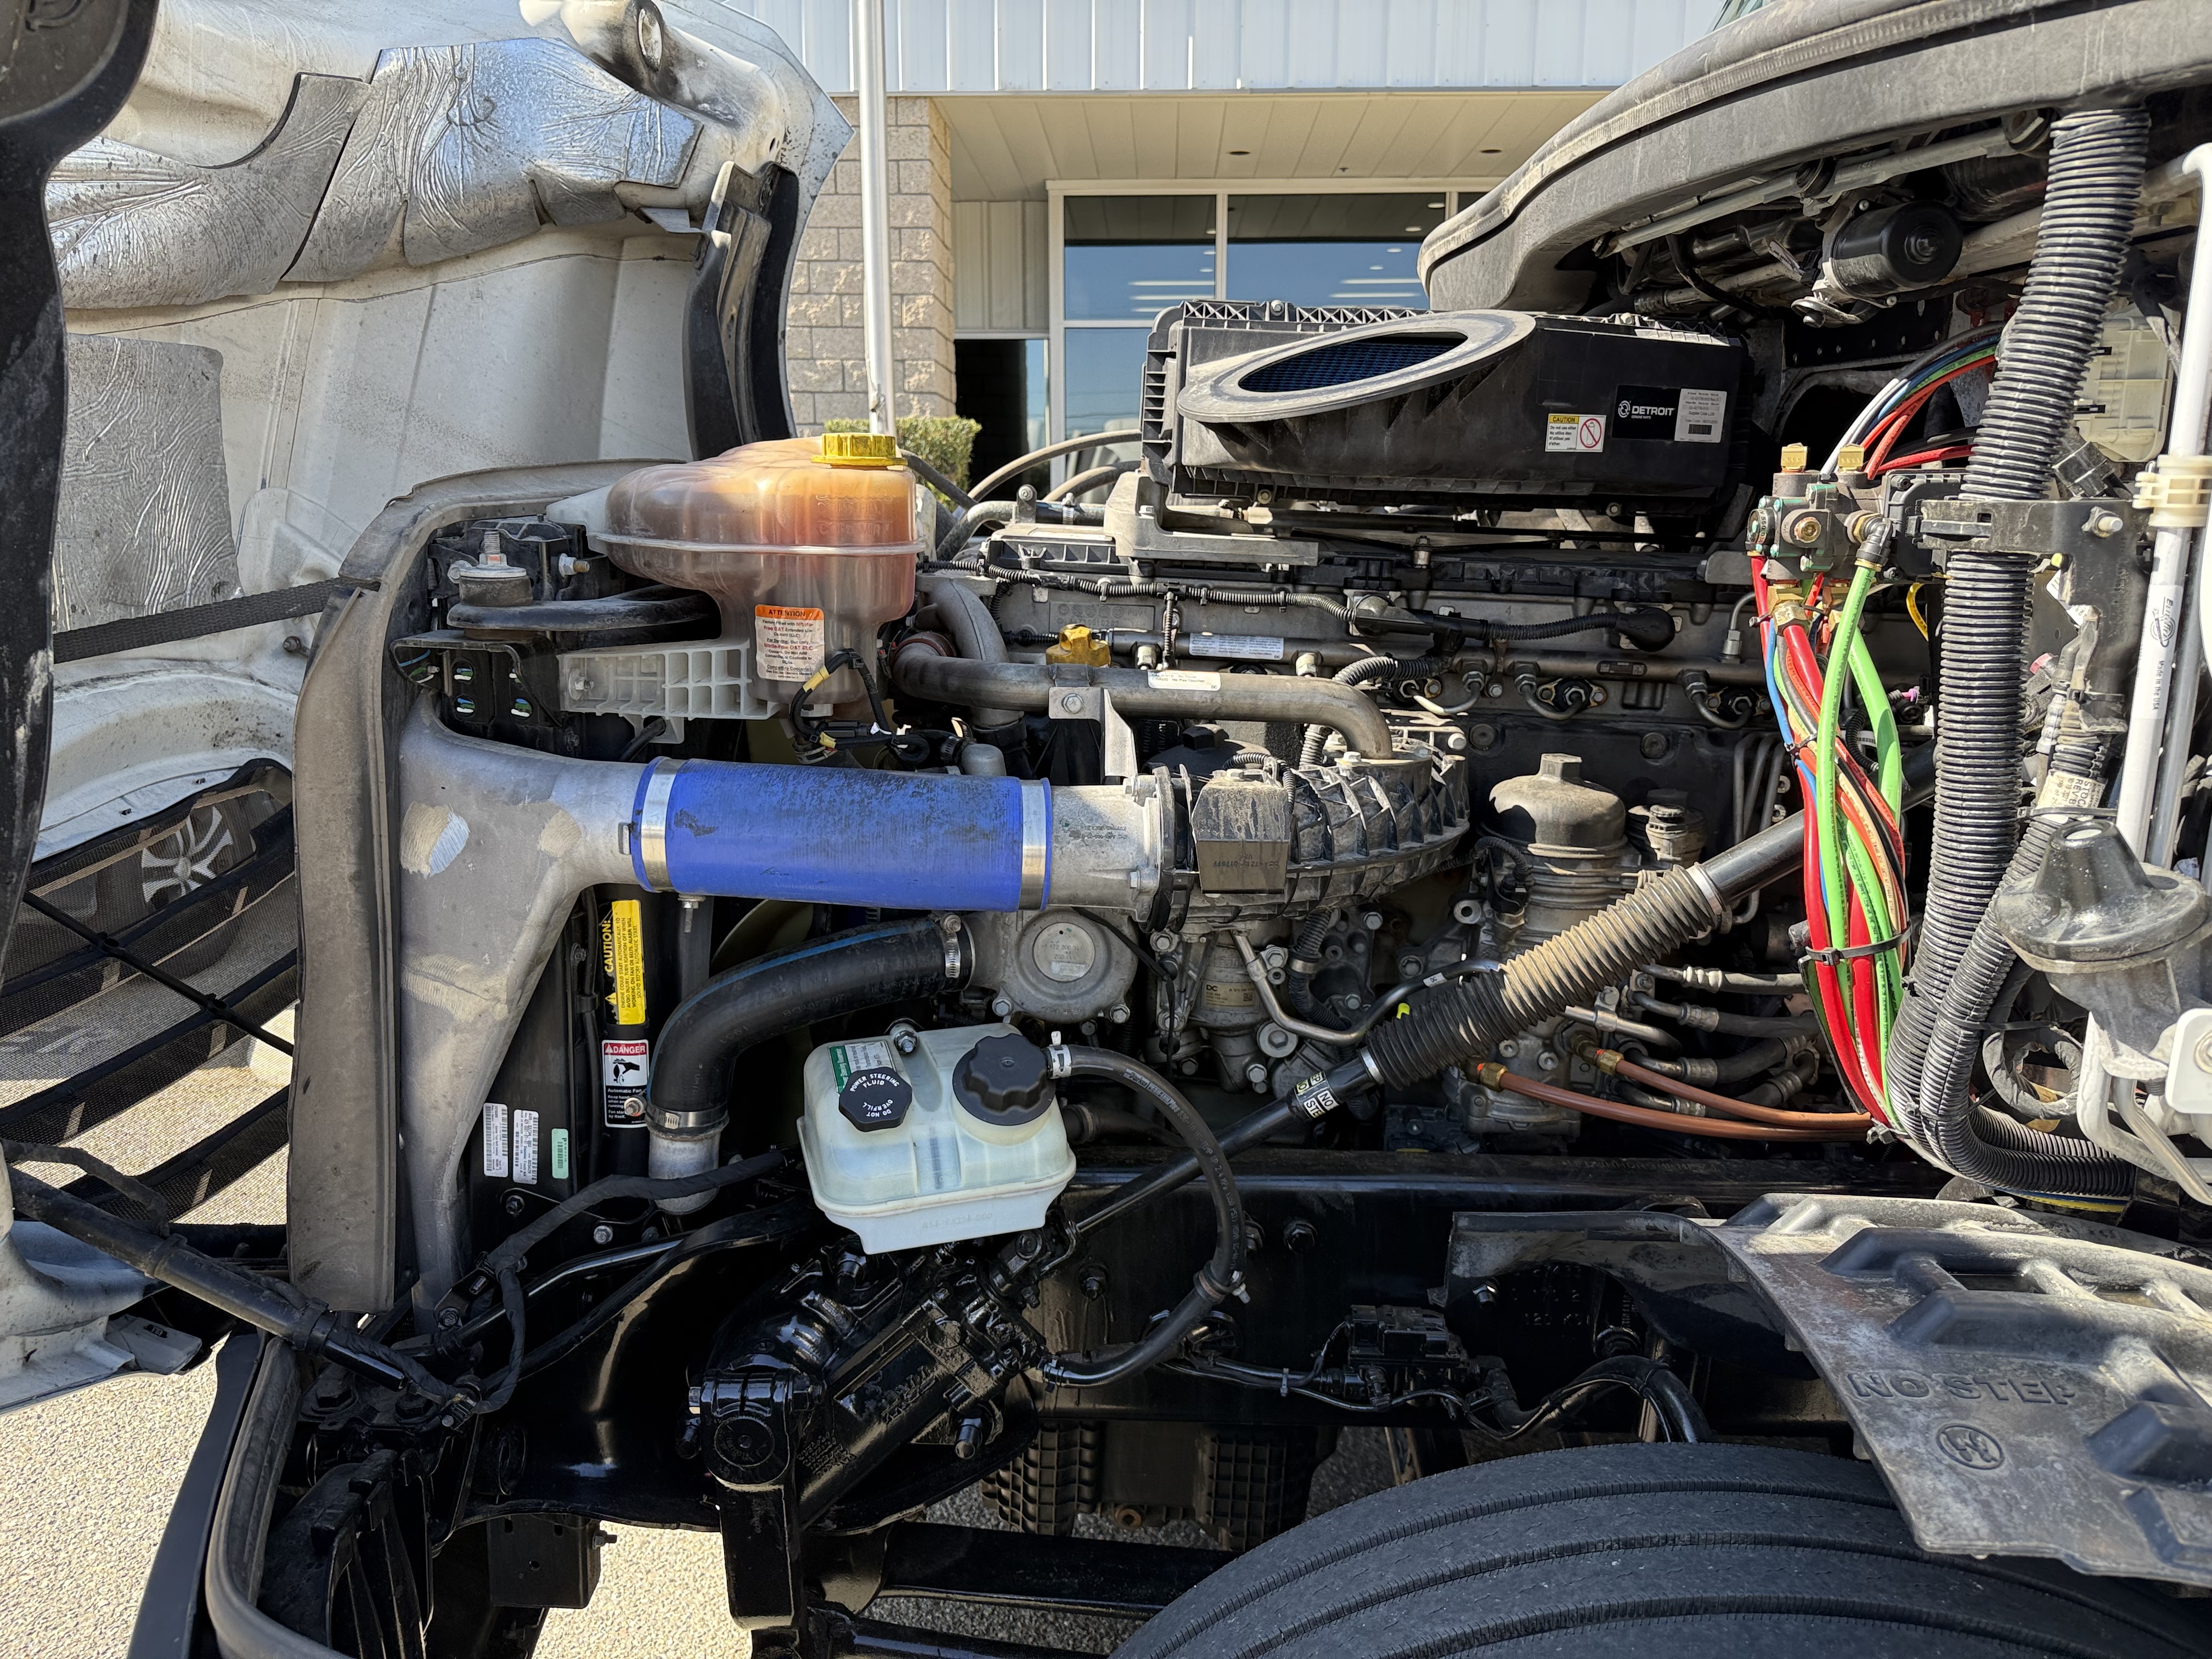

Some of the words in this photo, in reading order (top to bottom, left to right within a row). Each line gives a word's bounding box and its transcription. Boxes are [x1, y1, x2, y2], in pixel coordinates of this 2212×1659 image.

[1632, 405, 1674, 416] DETROIT
[1505, 605, 1511, 615] 4
[2156, 660, 2164, 676] Made
[2072, 779, 2083, 797] REV
[602, 920, 614, 973] CAUTION:
[630, 977, 635, 985] ON
[613, 1045, 645, 1054] DANGER
[850, 1076, 867, 1092] POWER
[870, 1073, 900, 1087] STEERING
[862, 1079, 885, 1088] FLUID
[1128, 1071, 1150, 1088] Parker
[862, 1099, 893, 1111] OVERFILL
[1319, 1093, 1334, 1107] NO
[1306, 1101, 1323, 1116] STE
[1848, 1373, 1929, 1398] NO
[1943, 1375, 2075, 1405] STEP
